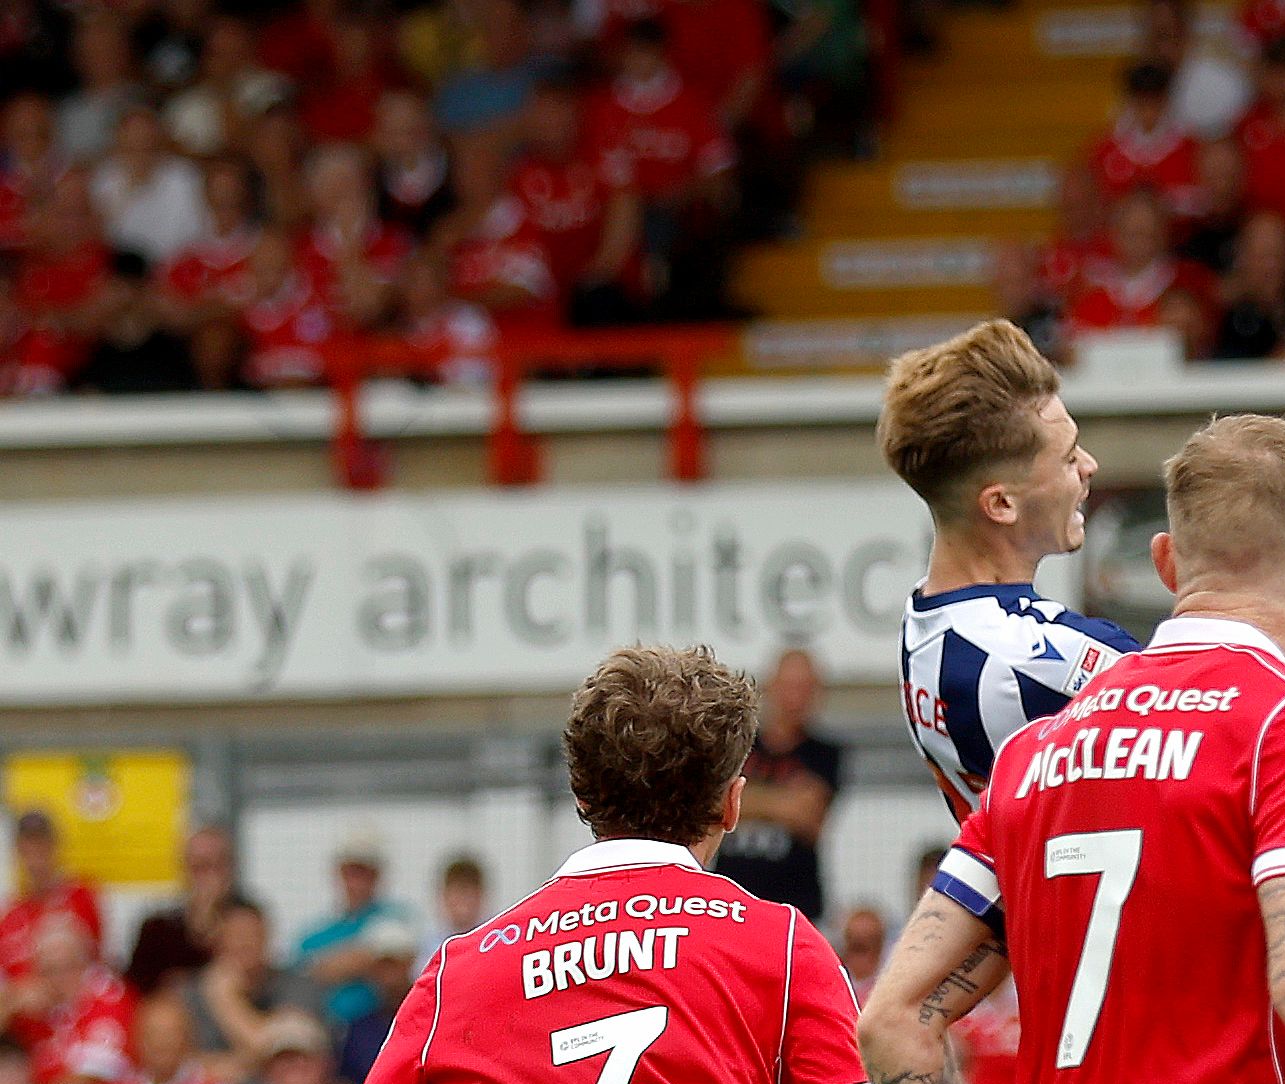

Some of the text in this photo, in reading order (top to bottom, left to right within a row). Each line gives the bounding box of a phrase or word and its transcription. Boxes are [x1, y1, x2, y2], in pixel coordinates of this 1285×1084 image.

[1125, 685, 1241, 717] Quest
[526, 894, 747, 941] Meta Quest
[521, 926, 689, 1000] BRUNT
[1043, 828, 1143, 1070] 7
